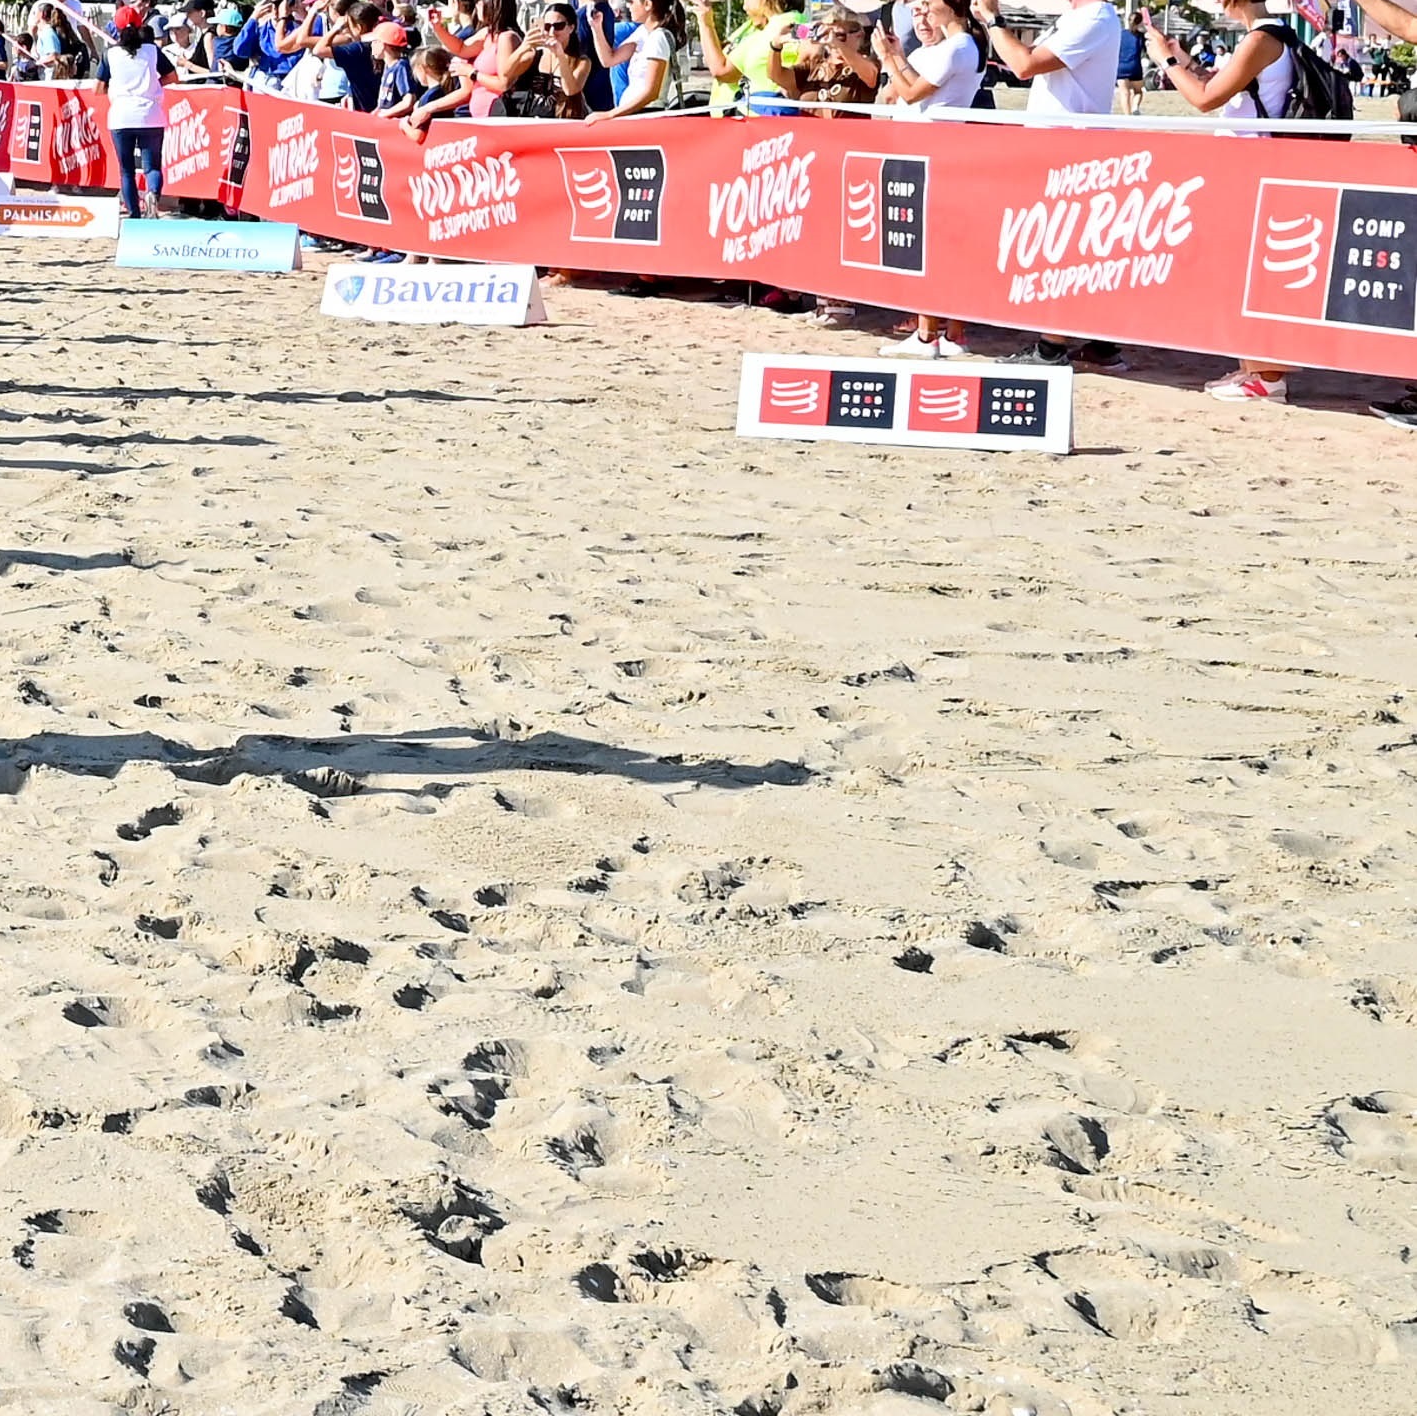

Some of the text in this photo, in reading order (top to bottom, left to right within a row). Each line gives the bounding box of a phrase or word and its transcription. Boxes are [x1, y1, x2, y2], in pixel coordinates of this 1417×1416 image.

[424, 136, 478, 170] WHEREVER
[624, 167, 657, 181] COMP
[1044, 150, 1153, 199] WHEREVER
[408, 151, 521, 220] YOU RACE
[887, 181, 916, 198] COMP
[361, 192, 379, 205] PORT
[709, 151, 816, 238] YOU RACE
[3, 209, 82, 223] PALMISANO
[443, 207, 490, 240] SUPPORT
[491, 202, 517, 227] YOU
[623, 209, 652, 223] PORT
[997, 175, 1205, 274] YOU RACE
[1352, 217, 1406, 239] COMP
[722, 237, 746, 264] WE
[779, 215, 804, 246] YOU
[887, 231, 914, 248] PORT
[1347, 247, 1401, 270] RESS
[1008, 253, 1174, 305] WE SUPPORT YOU
[372, 274, 520, 305] Bavaria
[841, 380, 885, 393] COMP
[992, 388, 1037, 400] COMP
[841, 394, 883, 406] RESS
[991, 400, 1035, 413] RESS
[840, 406, 882, 419] PORT
[990, 413, 1033, 427] PORT
